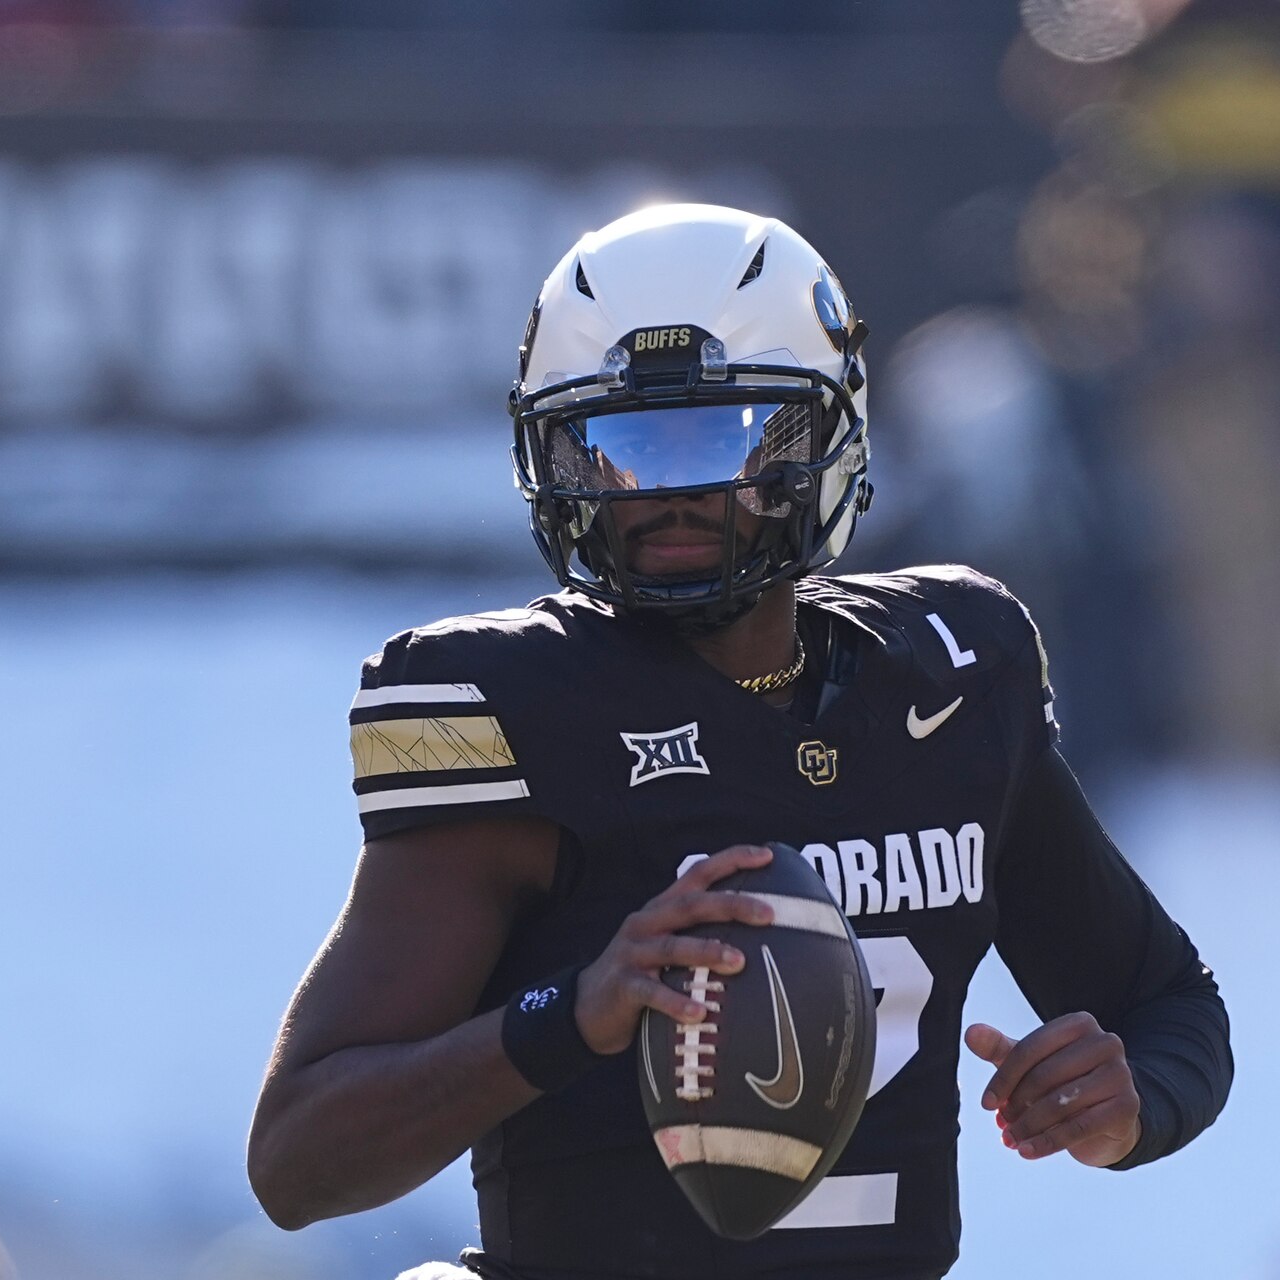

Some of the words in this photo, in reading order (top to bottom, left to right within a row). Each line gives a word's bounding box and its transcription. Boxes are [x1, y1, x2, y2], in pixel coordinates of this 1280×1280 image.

[634, 327, 691, 352] BUFFS
[925, 612, 977, 669] L
[798, 740, 837, 785] CU
[677, 822, 985, 916] ORADO
